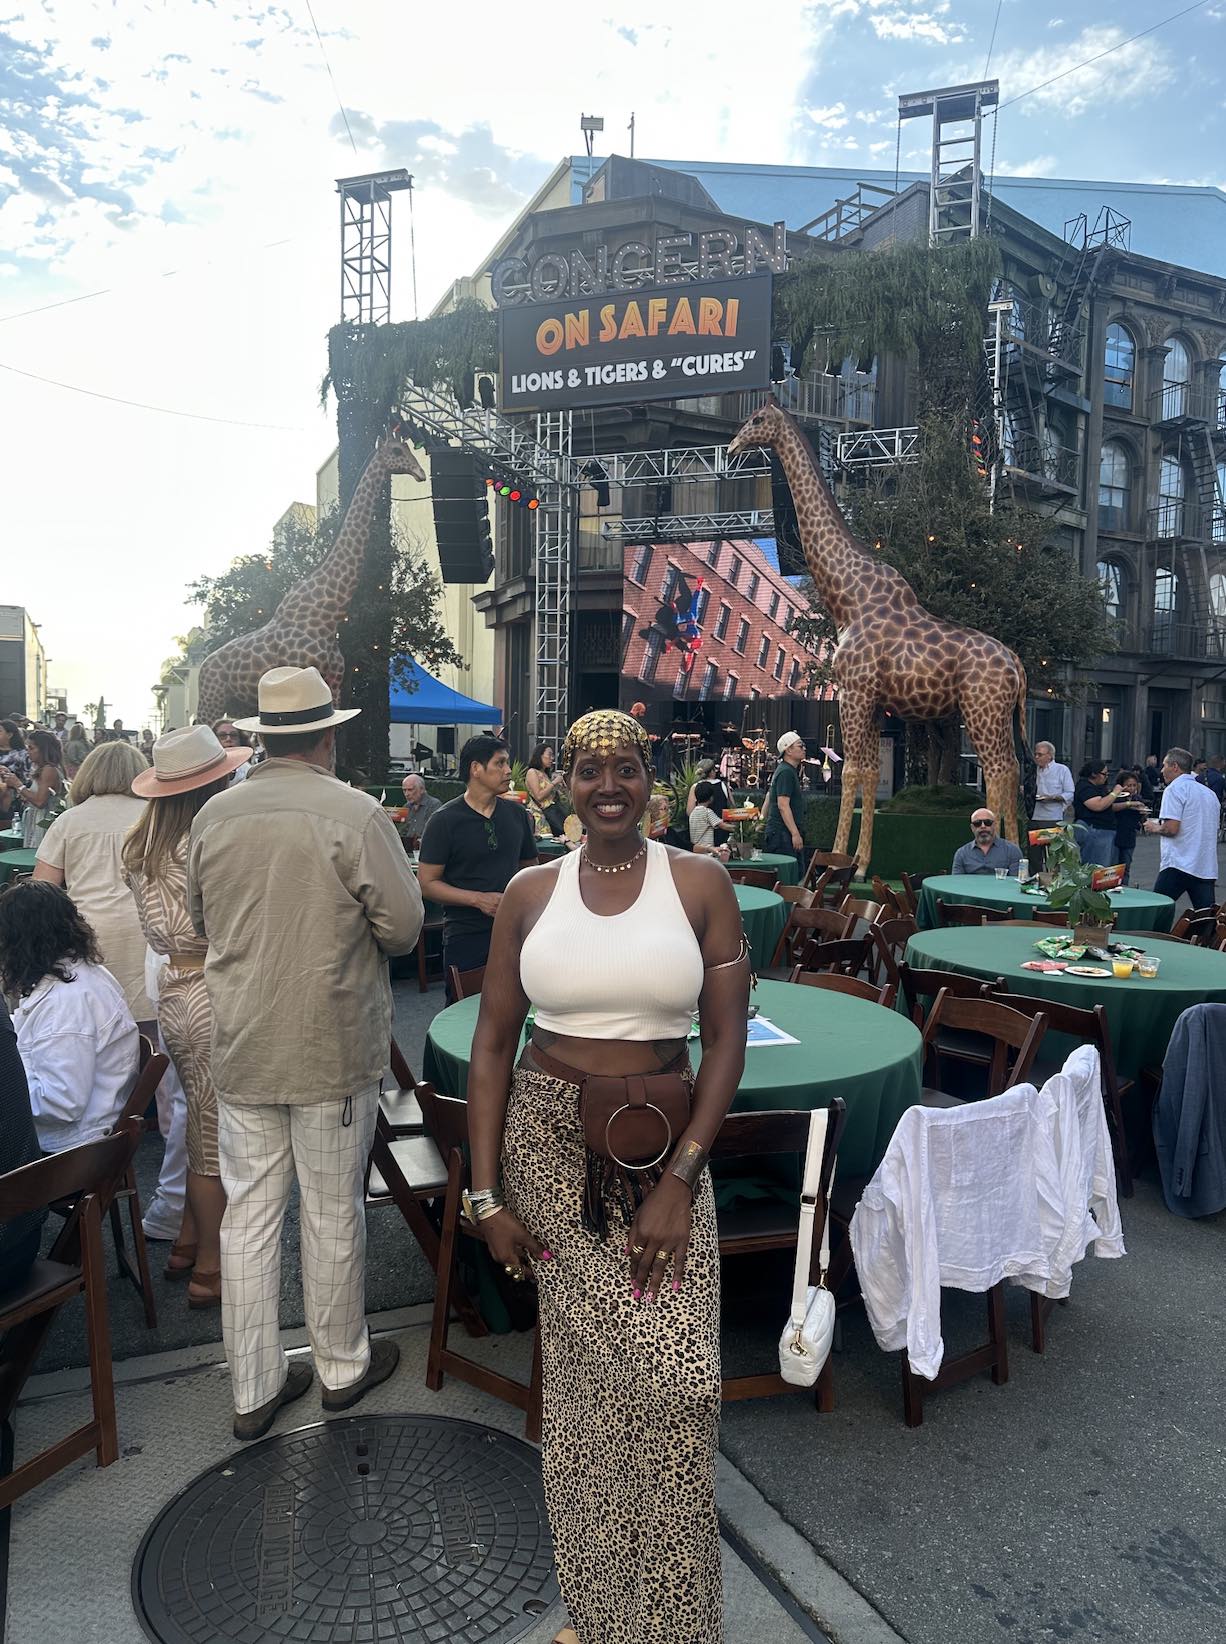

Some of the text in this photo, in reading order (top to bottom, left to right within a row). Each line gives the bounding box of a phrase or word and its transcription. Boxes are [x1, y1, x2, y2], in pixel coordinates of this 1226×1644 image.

[490, 220, 787, 305] CONCERN
[536, 297, 740, 356] ON SAFARI
[511, 350, 757, 394] LIONS & TIGERS & "CURES"
[261, 1485, 292, 1615] HIGH VOLTAGE
[440, 1484, 475, 1562] ELECTRIC
